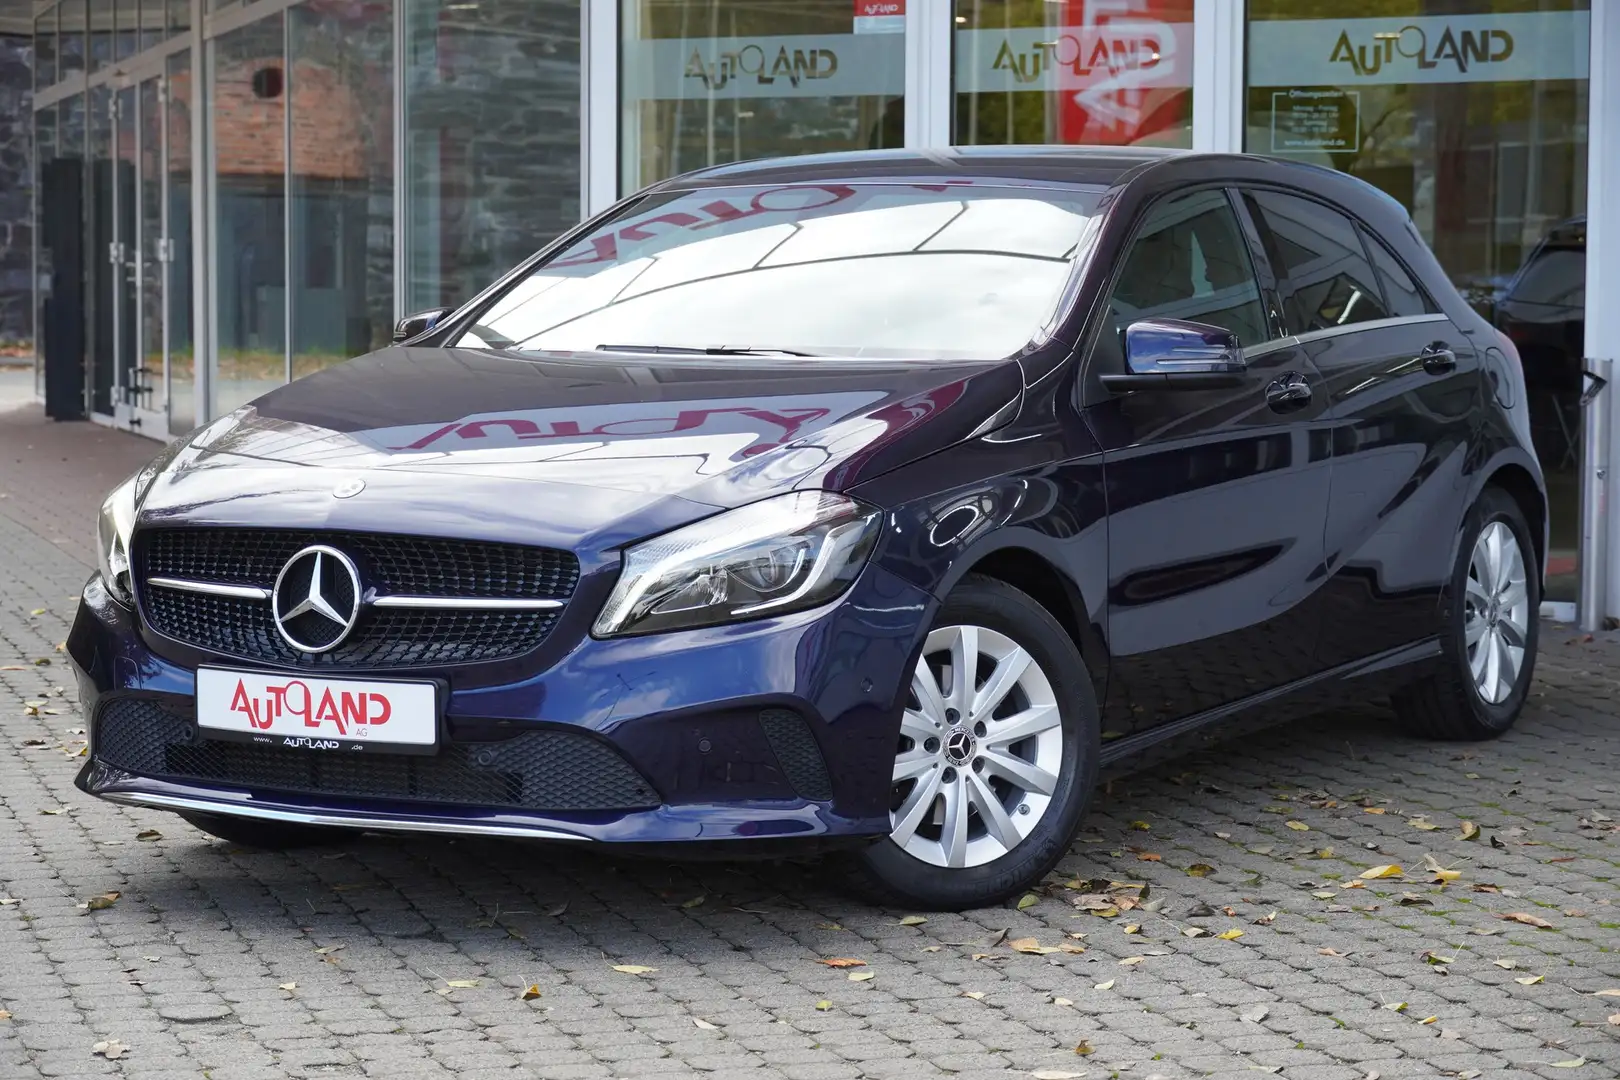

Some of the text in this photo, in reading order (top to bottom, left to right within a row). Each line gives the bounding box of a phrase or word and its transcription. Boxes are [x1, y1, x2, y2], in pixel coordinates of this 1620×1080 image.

[864, 4, 899, 15] AUTOLAND
[684, 44, 838, 90] AUTOLAND
[991, 34, 1161, 83] AUTOLAND
[1329, 25, 1514, 75] AUTOLAND
[230, 678, 391, 735] AUTOLAND
[253, 736, 273, 744] www.
[283, 736, 339, 749] AUTOLAND
[356, 728, 367, 737] AG
